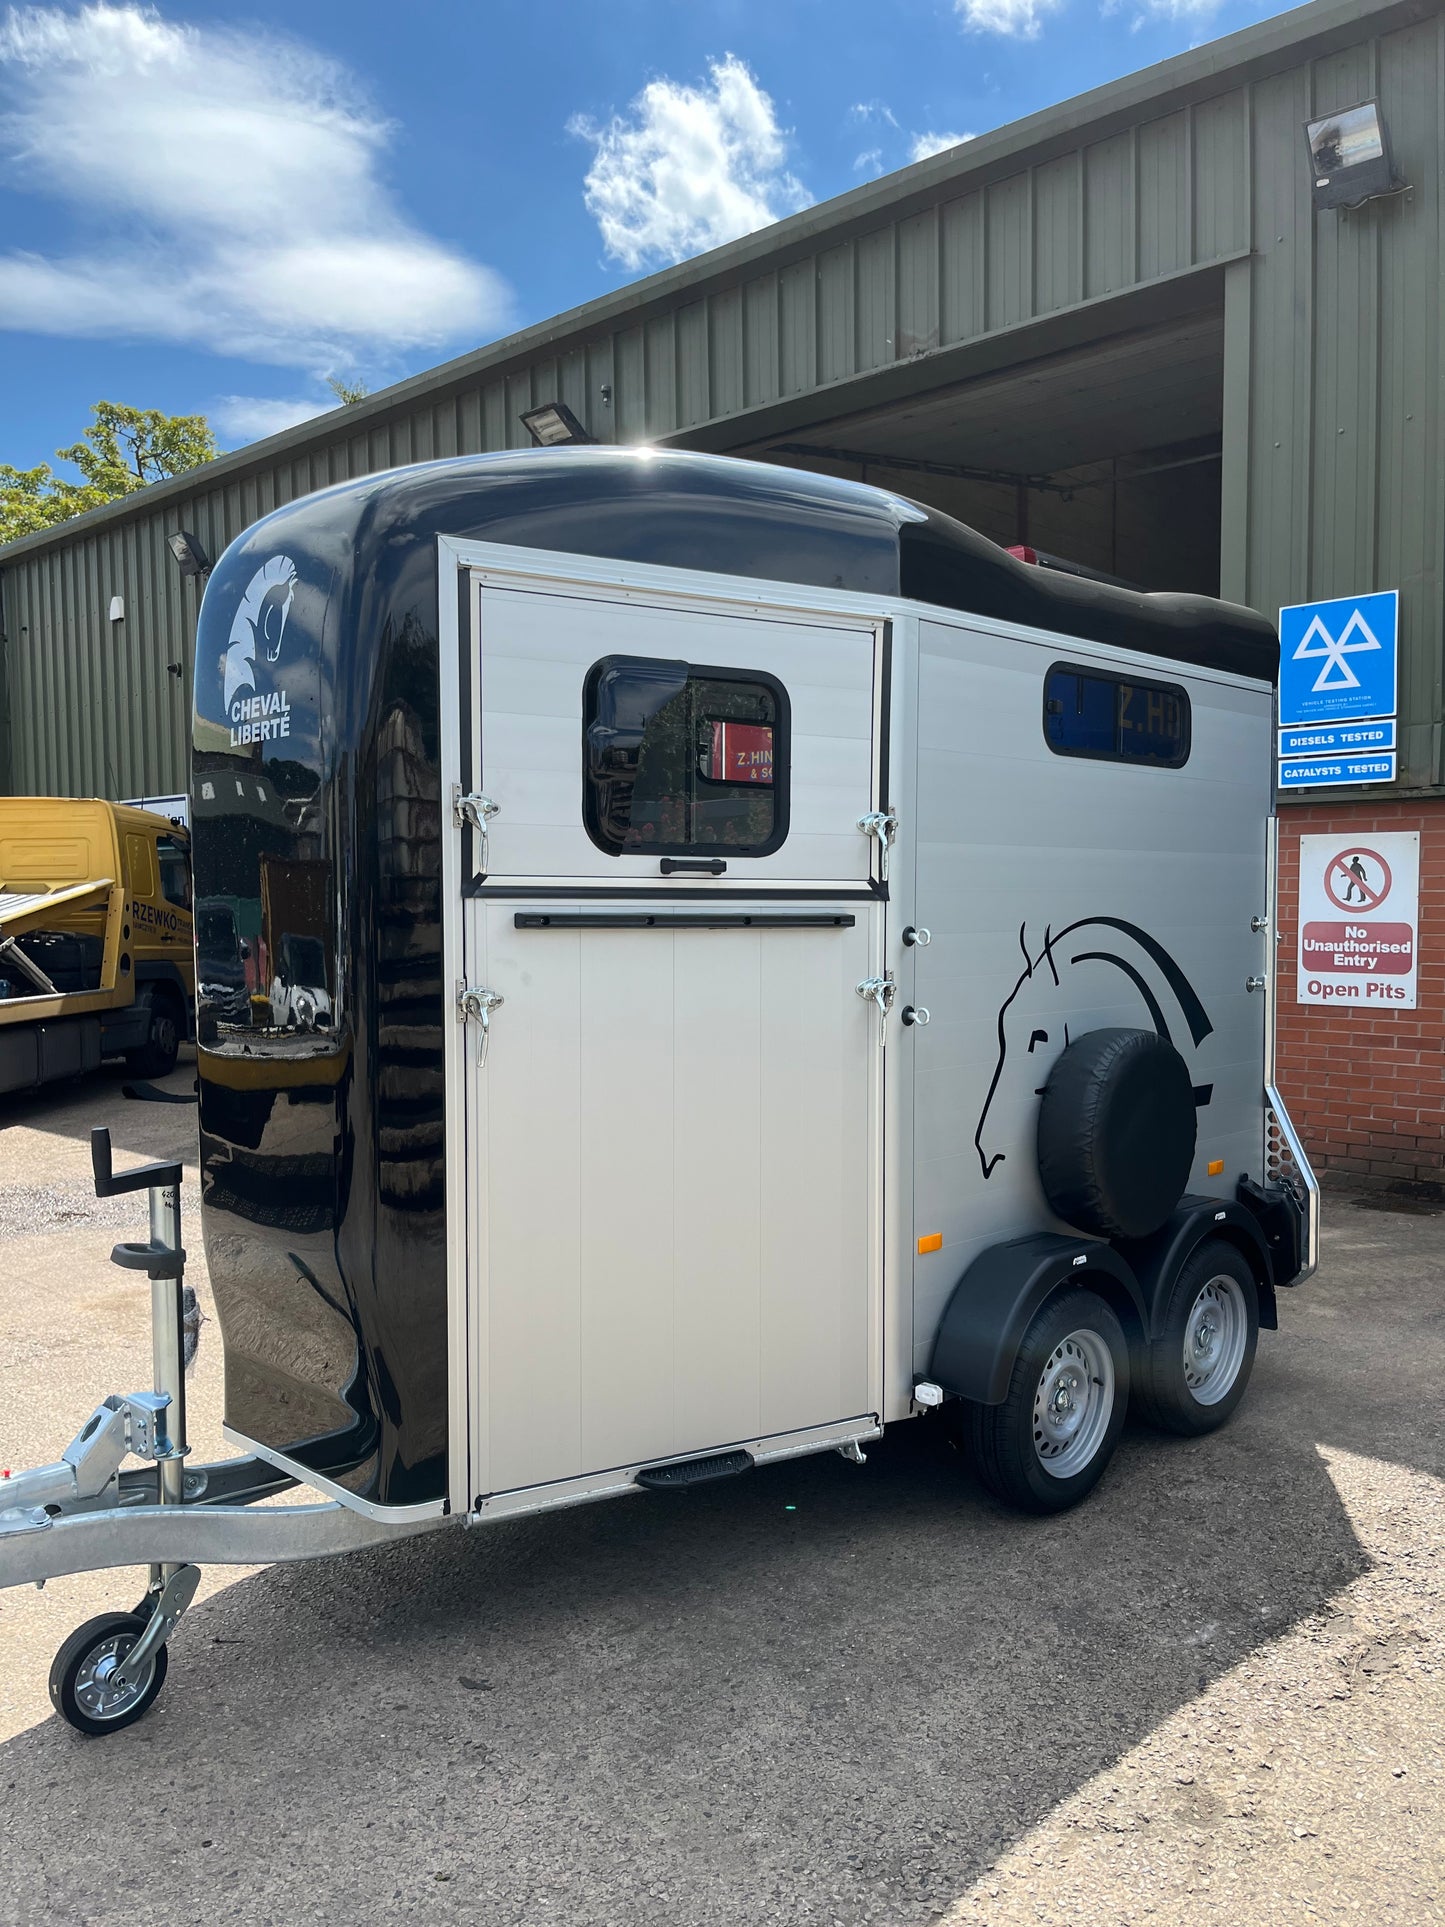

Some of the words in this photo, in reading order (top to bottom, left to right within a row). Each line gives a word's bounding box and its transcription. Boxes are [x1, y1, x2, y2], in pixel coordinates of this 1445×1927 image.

[231, 690, 291, 723] CHEVAL
[230, 712, 291, 748] LIBERTÉ
[1290, 735, 1335, 747] DIESELS
[1340, 731, 1384, 743] TESTED
[751, 768, 758, 779] &
[1284, 766, 1342, 778] CATALYSTS
[1347, 763, 1390, 774] TESTED
[1344, 926, 1368, 939] No
[1303, 939, 1412, 954] Unauthorised
[1333, 953, 1378, 970] Entry
[1307, 980, 1360, 1000] Open
[1366, 982, 1406, 1000] Pits
